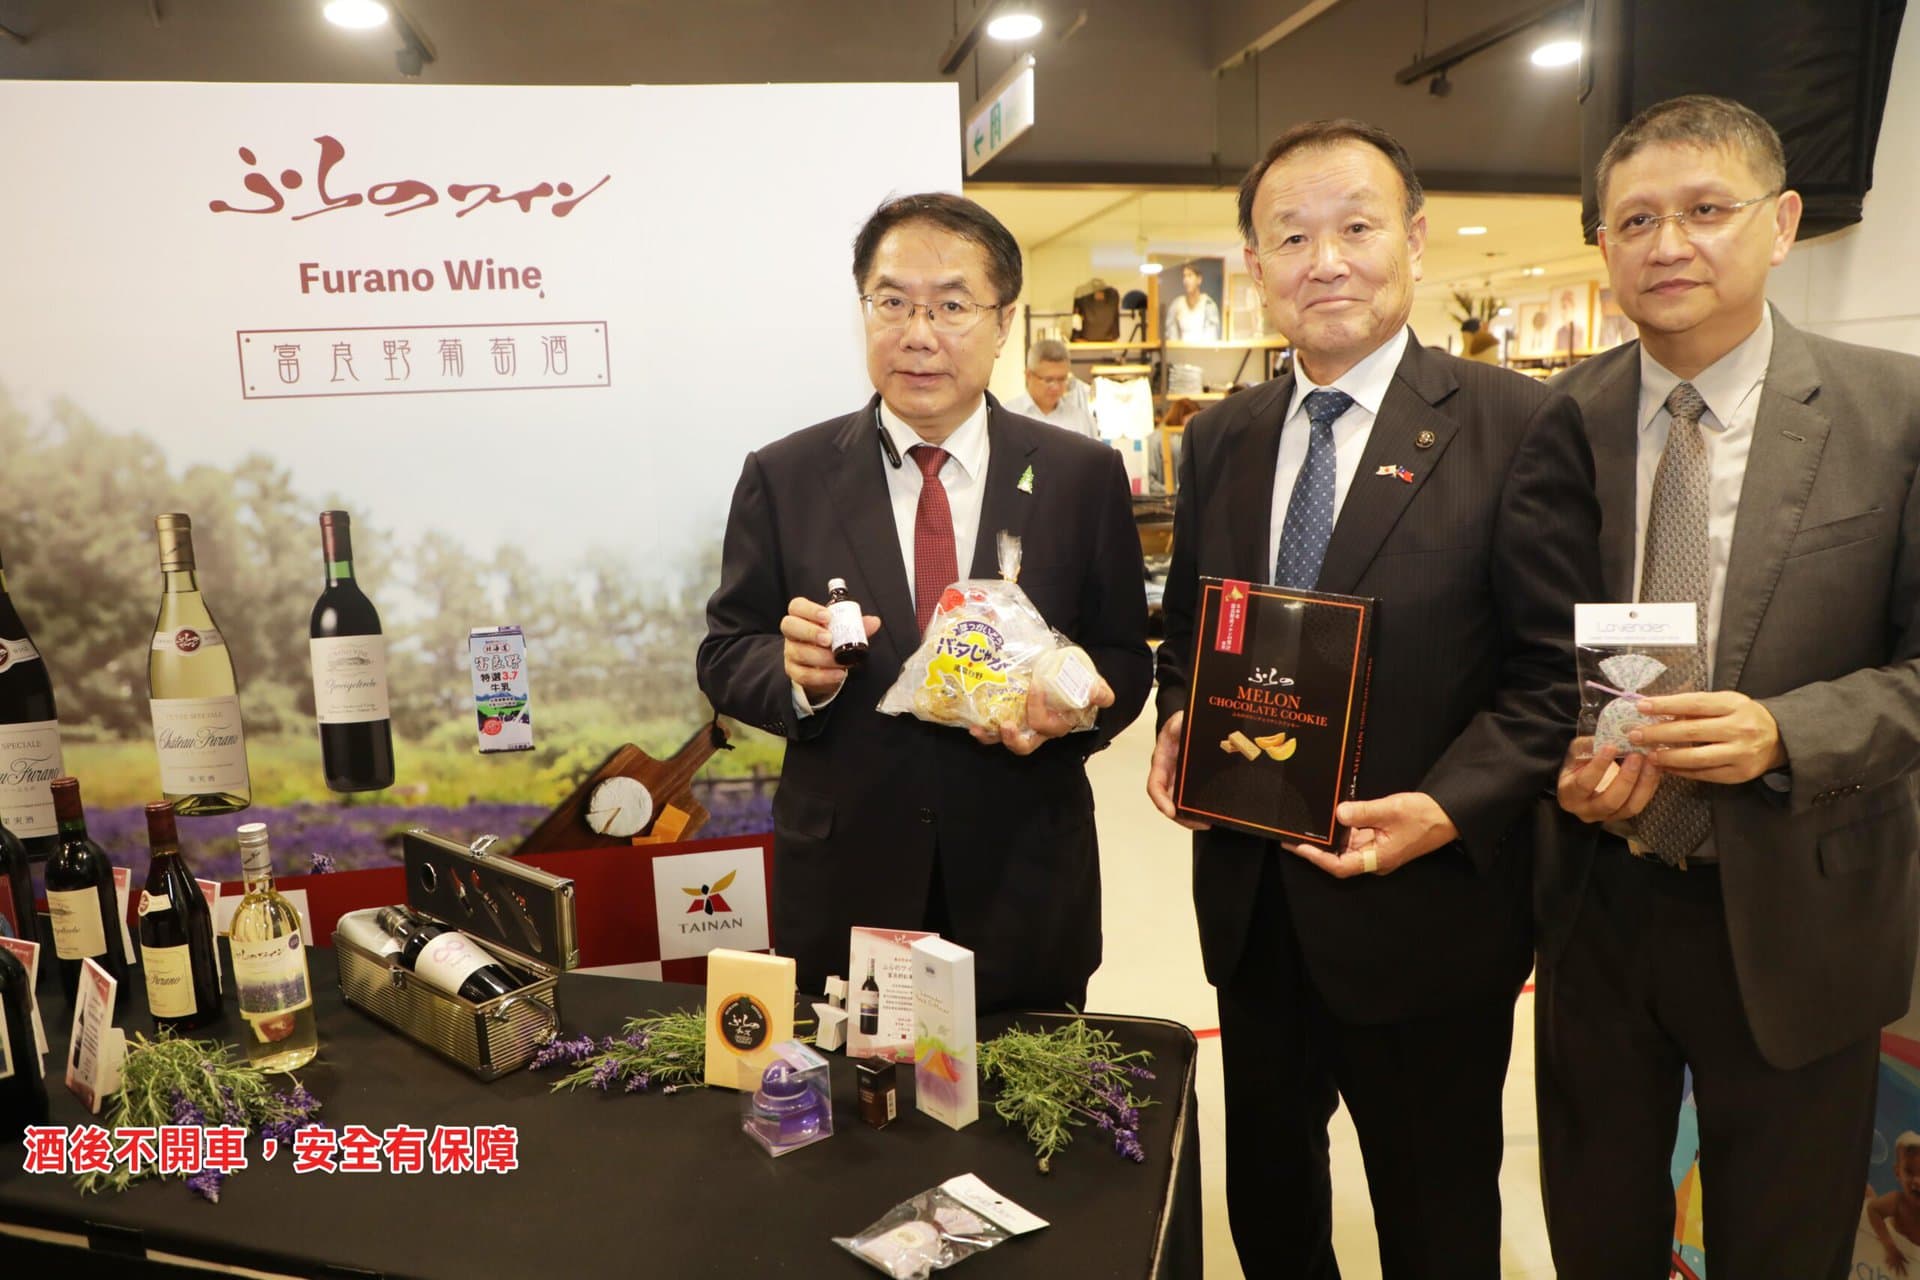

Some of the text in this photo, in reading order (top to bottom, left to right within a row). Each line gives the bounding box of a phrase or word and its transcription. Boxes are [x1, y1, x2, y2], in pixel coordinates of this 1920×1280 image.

[299, 258, 543, 294] Furano Wine
[272, 335, 570, 384] 富良野葡萄酒
[1208, 695, 1278, 718] CHOCOLATE
[1280, 707, 1329, 727] COOKIE
[1236, 686, 1301, 710] MELON
[8, 753, 60, 786] Furano
[678, 918, 743, 934] TAINAN
